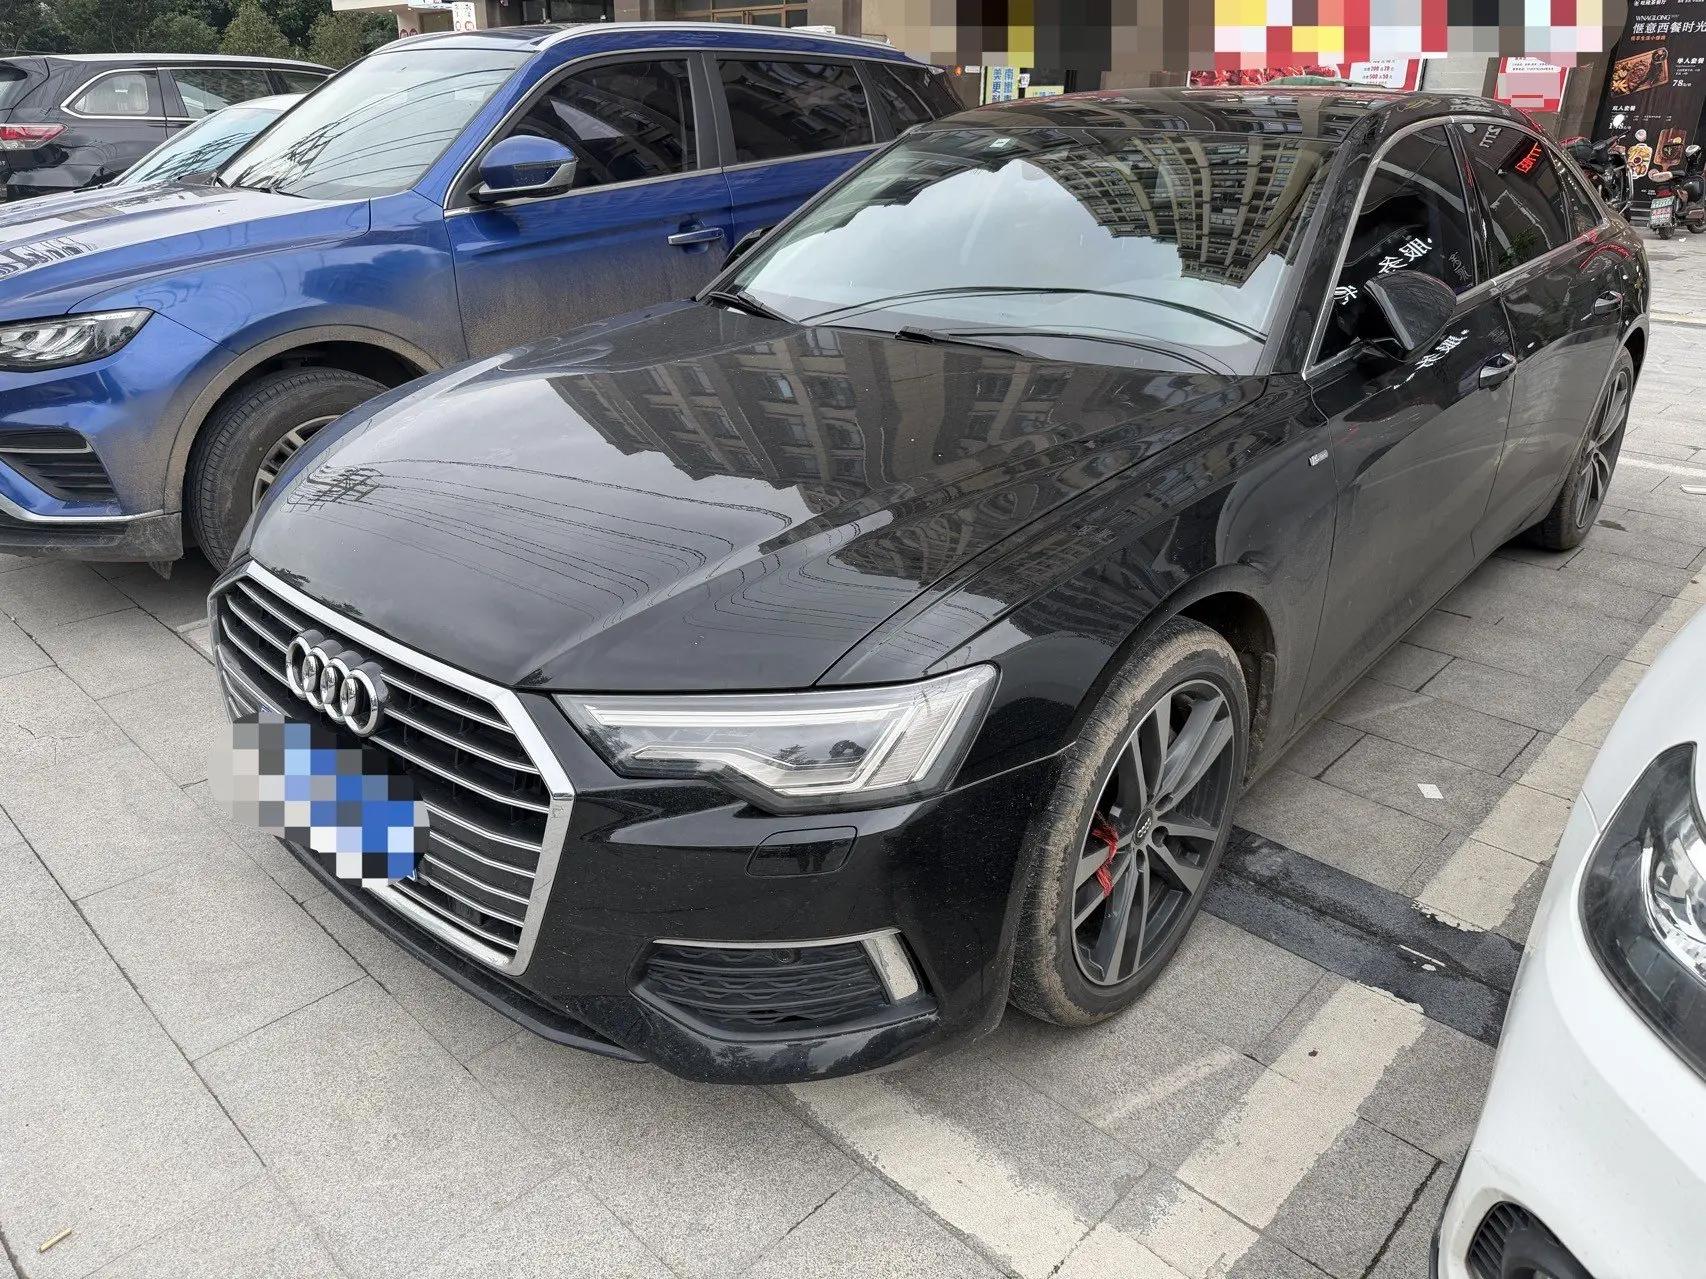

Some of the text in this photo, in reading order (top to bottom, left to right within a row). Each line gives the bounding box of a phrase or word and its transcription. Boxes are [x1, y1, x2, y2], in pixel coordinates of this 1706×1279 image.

[1633, 21, 1706, 34] 惬意西餐时光
